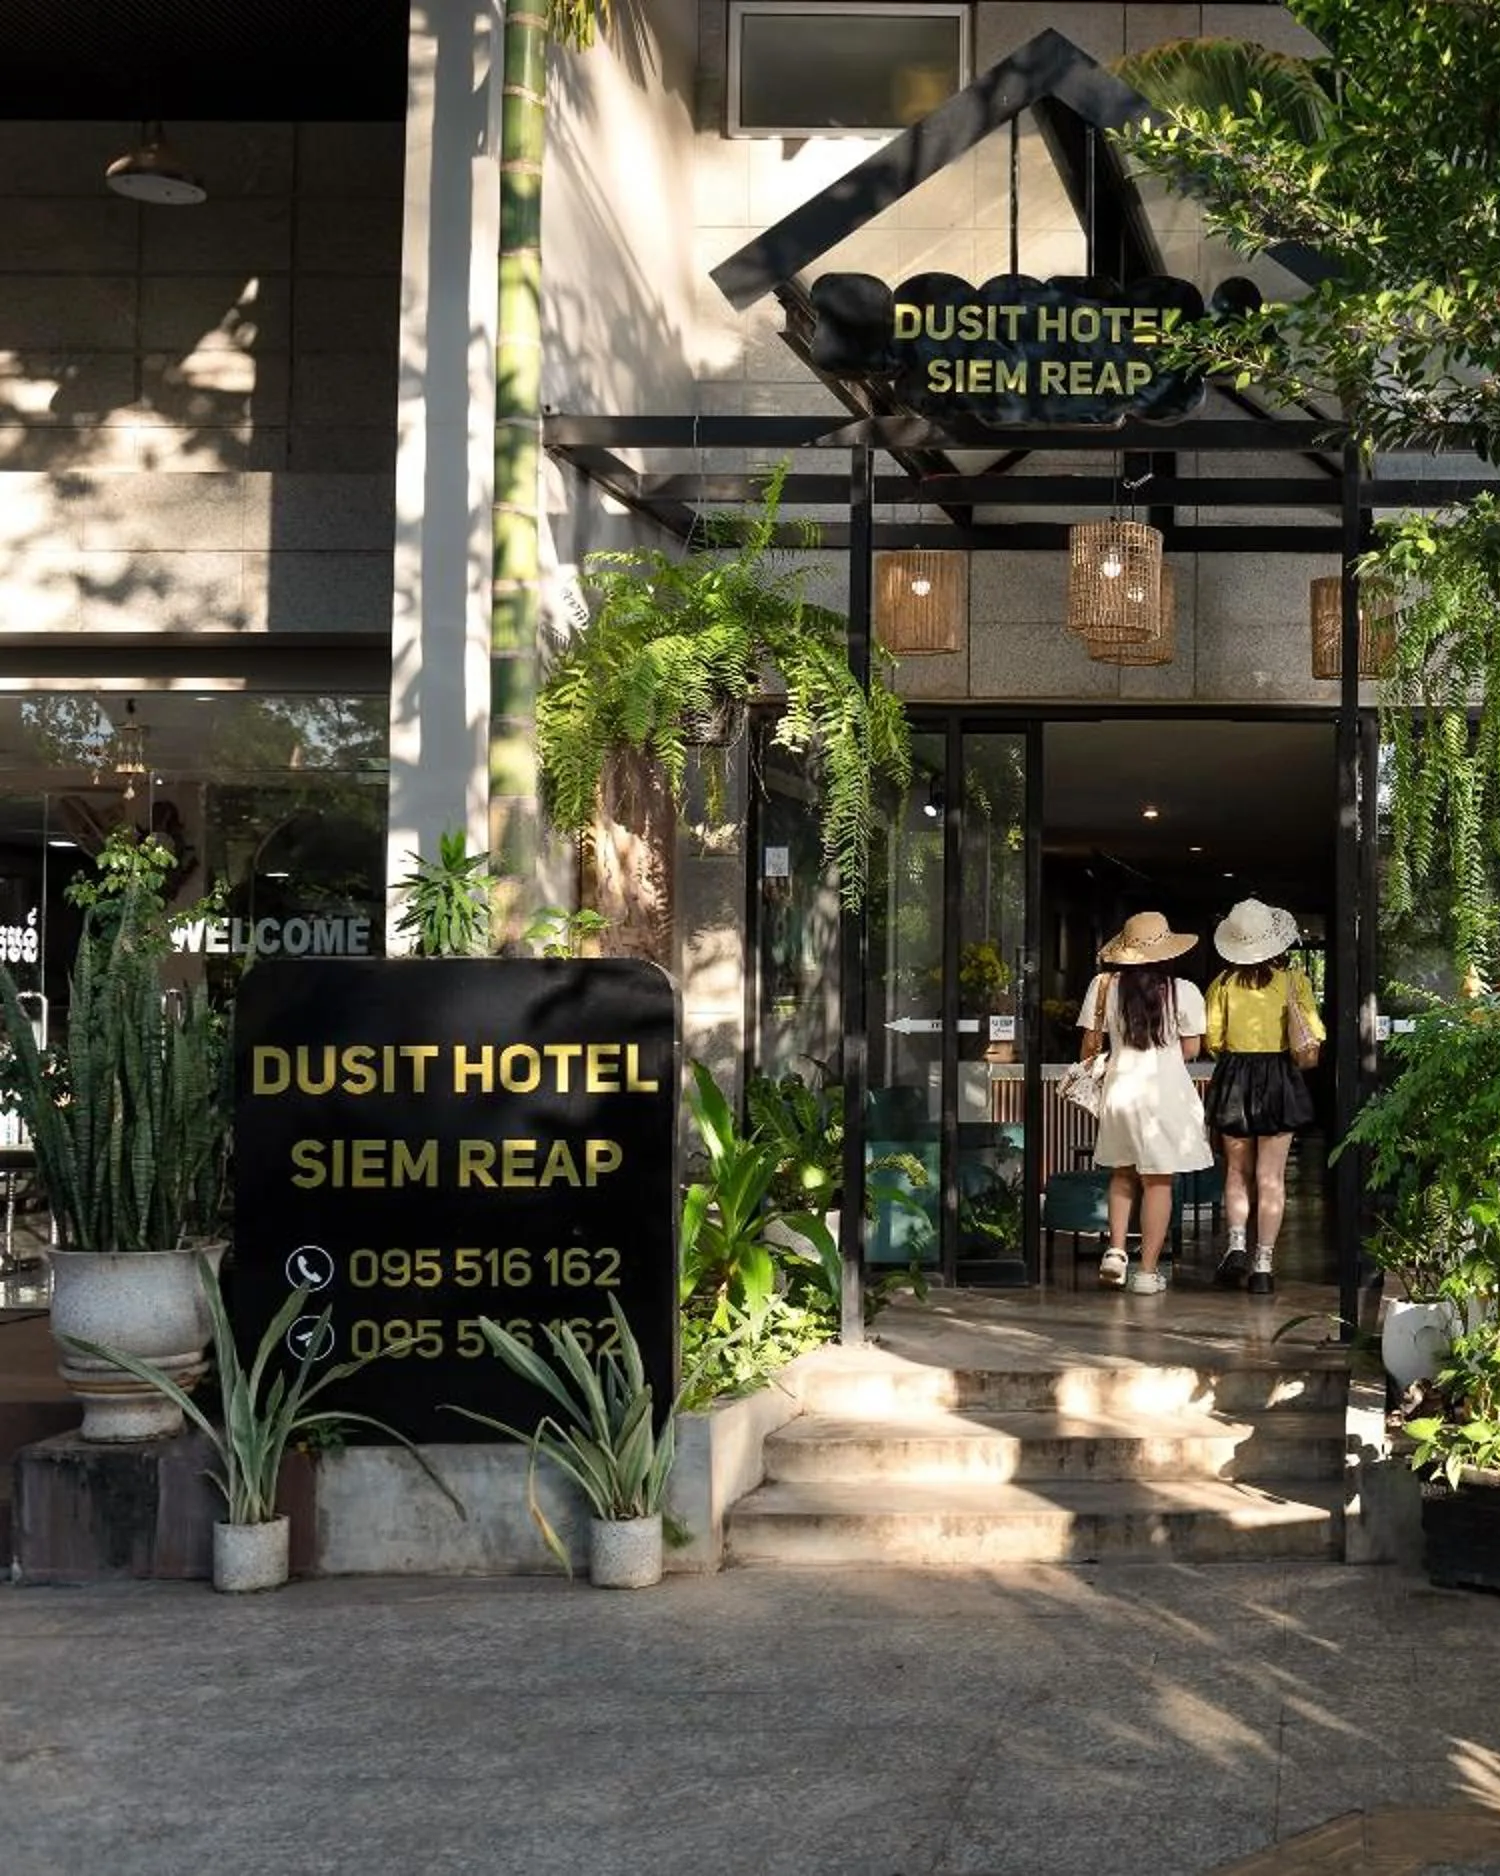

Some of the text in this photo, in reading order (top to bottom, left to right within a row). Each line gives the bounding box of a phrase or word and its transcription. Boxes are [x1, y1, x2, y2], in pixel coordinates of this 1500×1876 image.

[893, 304, 1026, 341] DUSIT
[926, 358, 1152, 394] SIEM REAP
[169, 917, 371, 954] WELCOME
[252, 1044, 659, 1094] DUSIT HOTEL
[291, 1139, 623, 1188] SIEM REAP
[349, 1247, 622, 1288] 095 516 162
[350, 1319, 443, 1359] 095
[457, 1318, 534, 1359] 56
